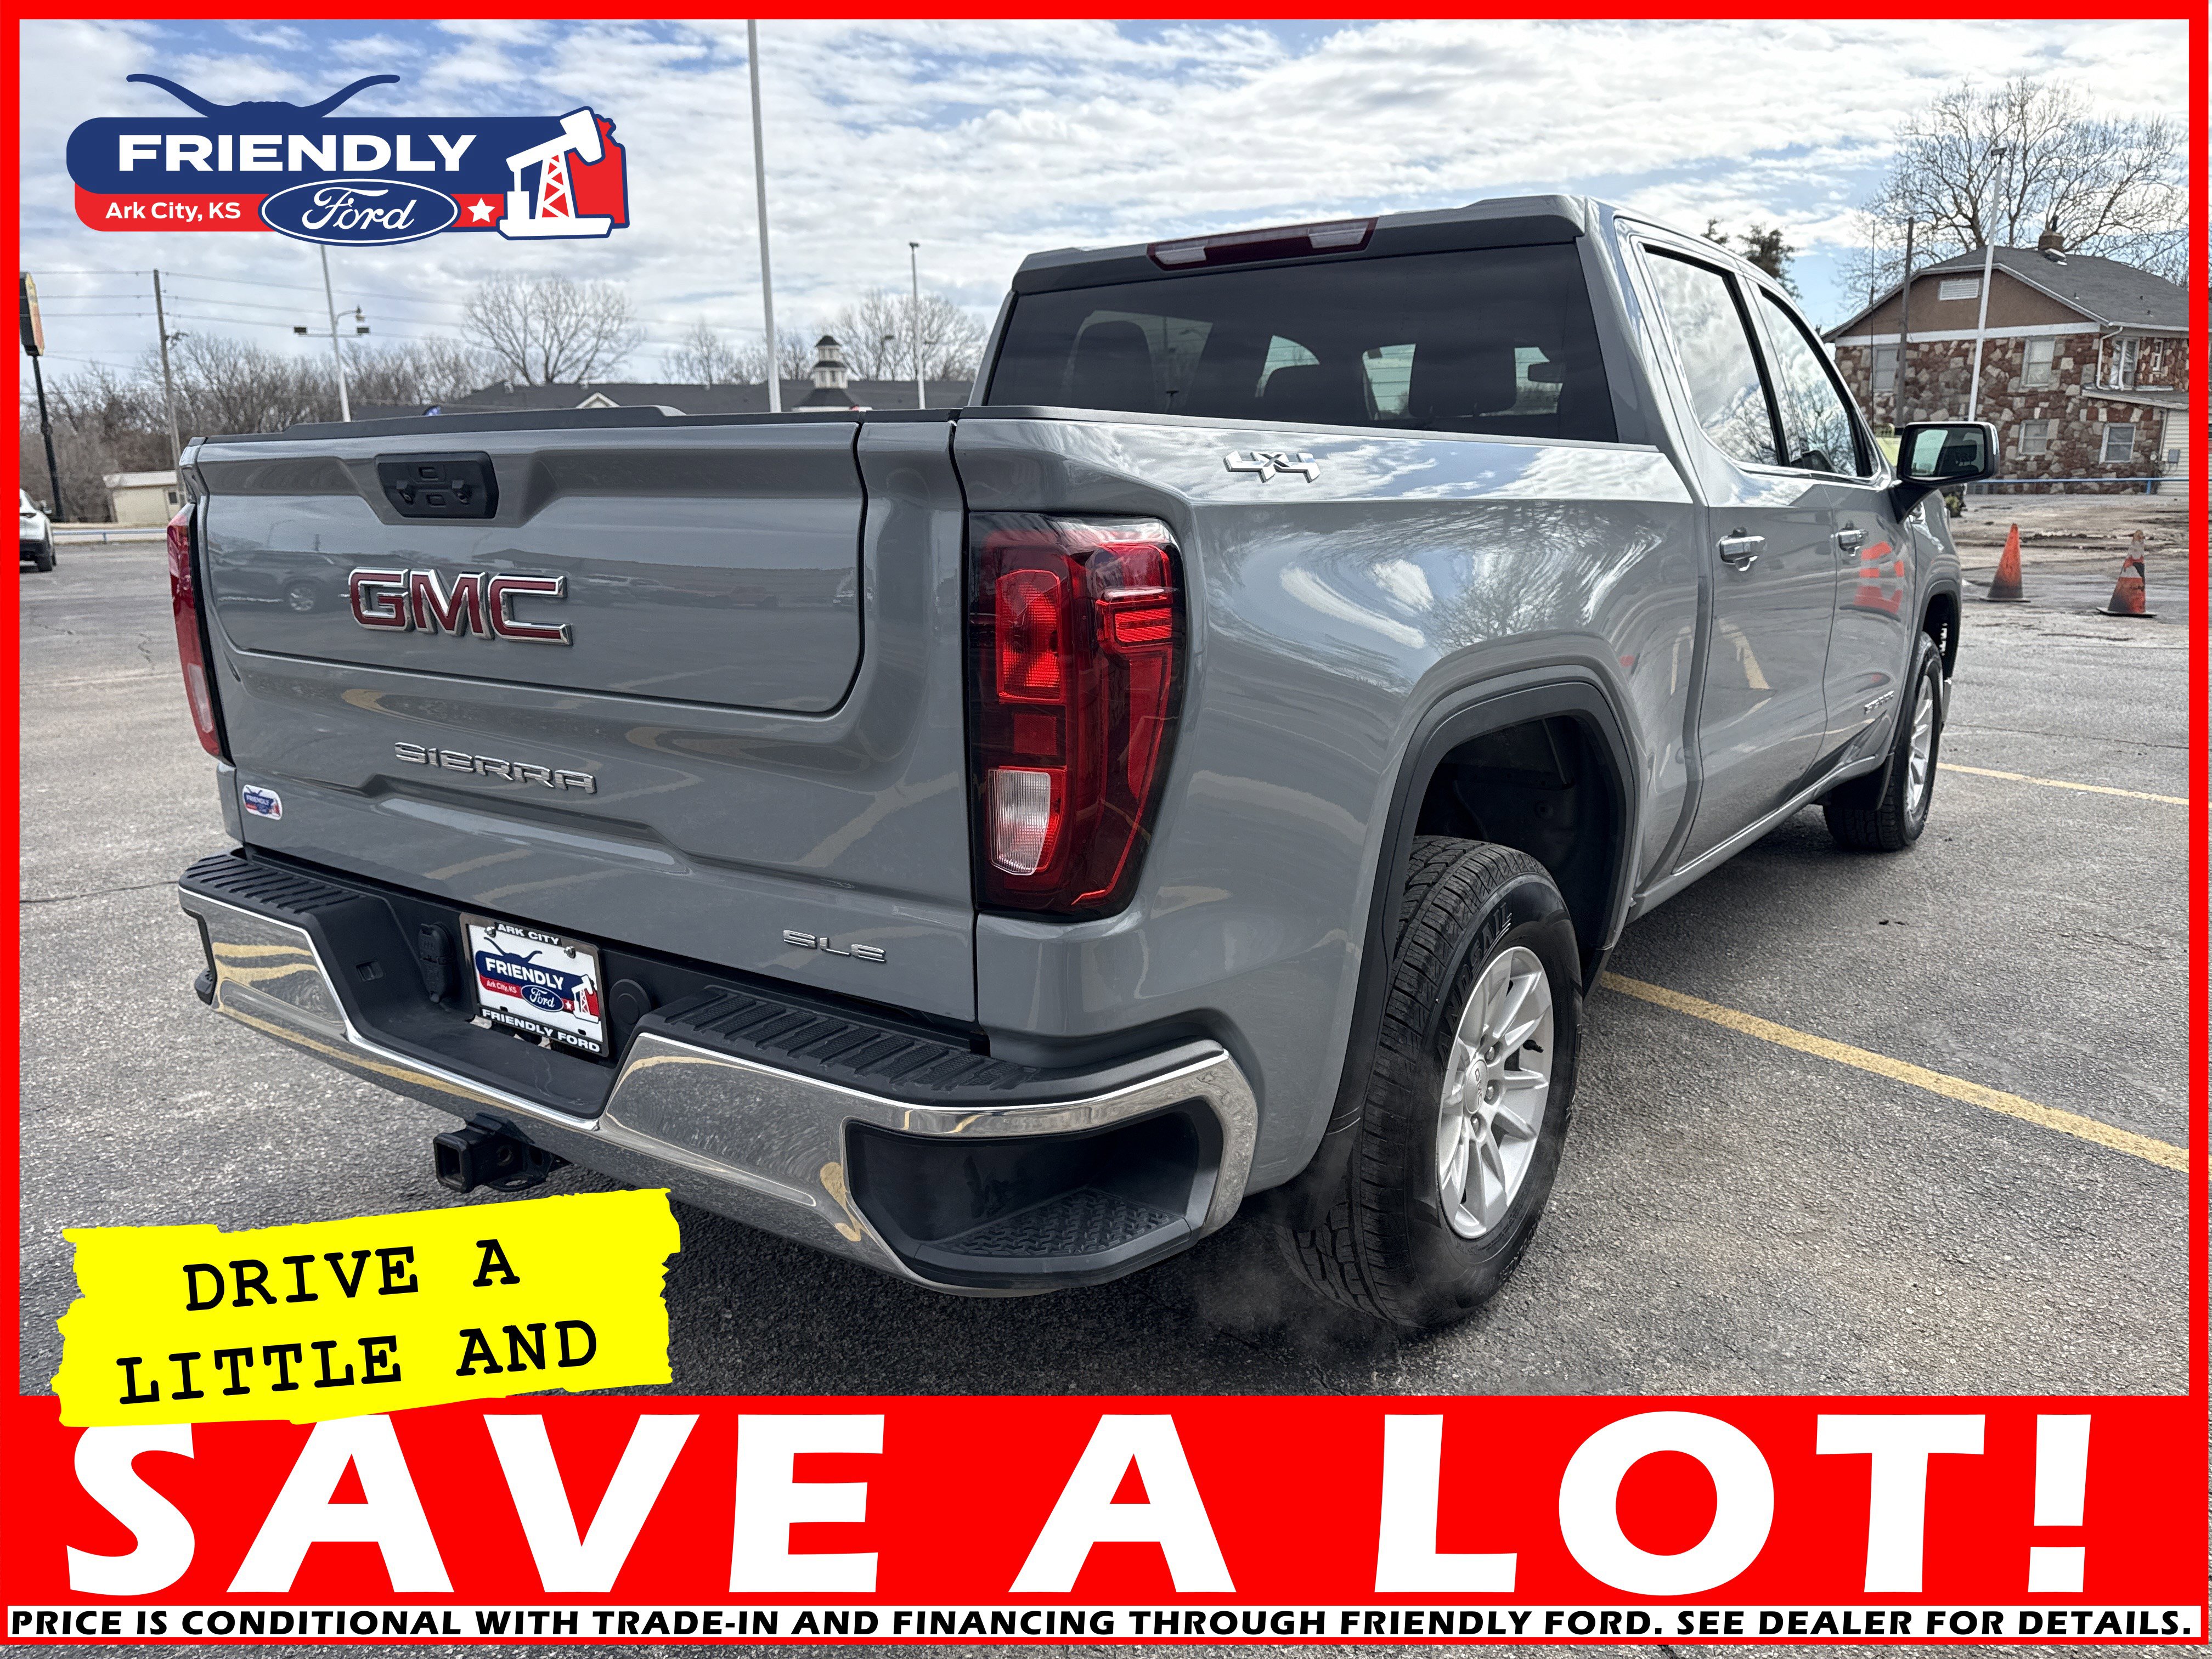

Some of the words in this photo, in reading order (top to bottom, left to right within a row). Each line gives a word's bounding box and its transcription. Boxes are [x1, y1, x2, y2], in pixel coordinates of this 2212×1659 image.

[348, 566, 574, 646] GMC
[394, 741, 598, 794] SIERRA
[498, 923, 525, 936] ARK
[528, 930, 560, 945] CITY
[783, 930, 887, 963] SLE
[485, 957, 565, 990] FRIENDLY
[529, 987, 556, 1008] Ford
[482, 1008, 554, 1037] FRIENDLY
[557, 1031, 600, 1053] FORD
